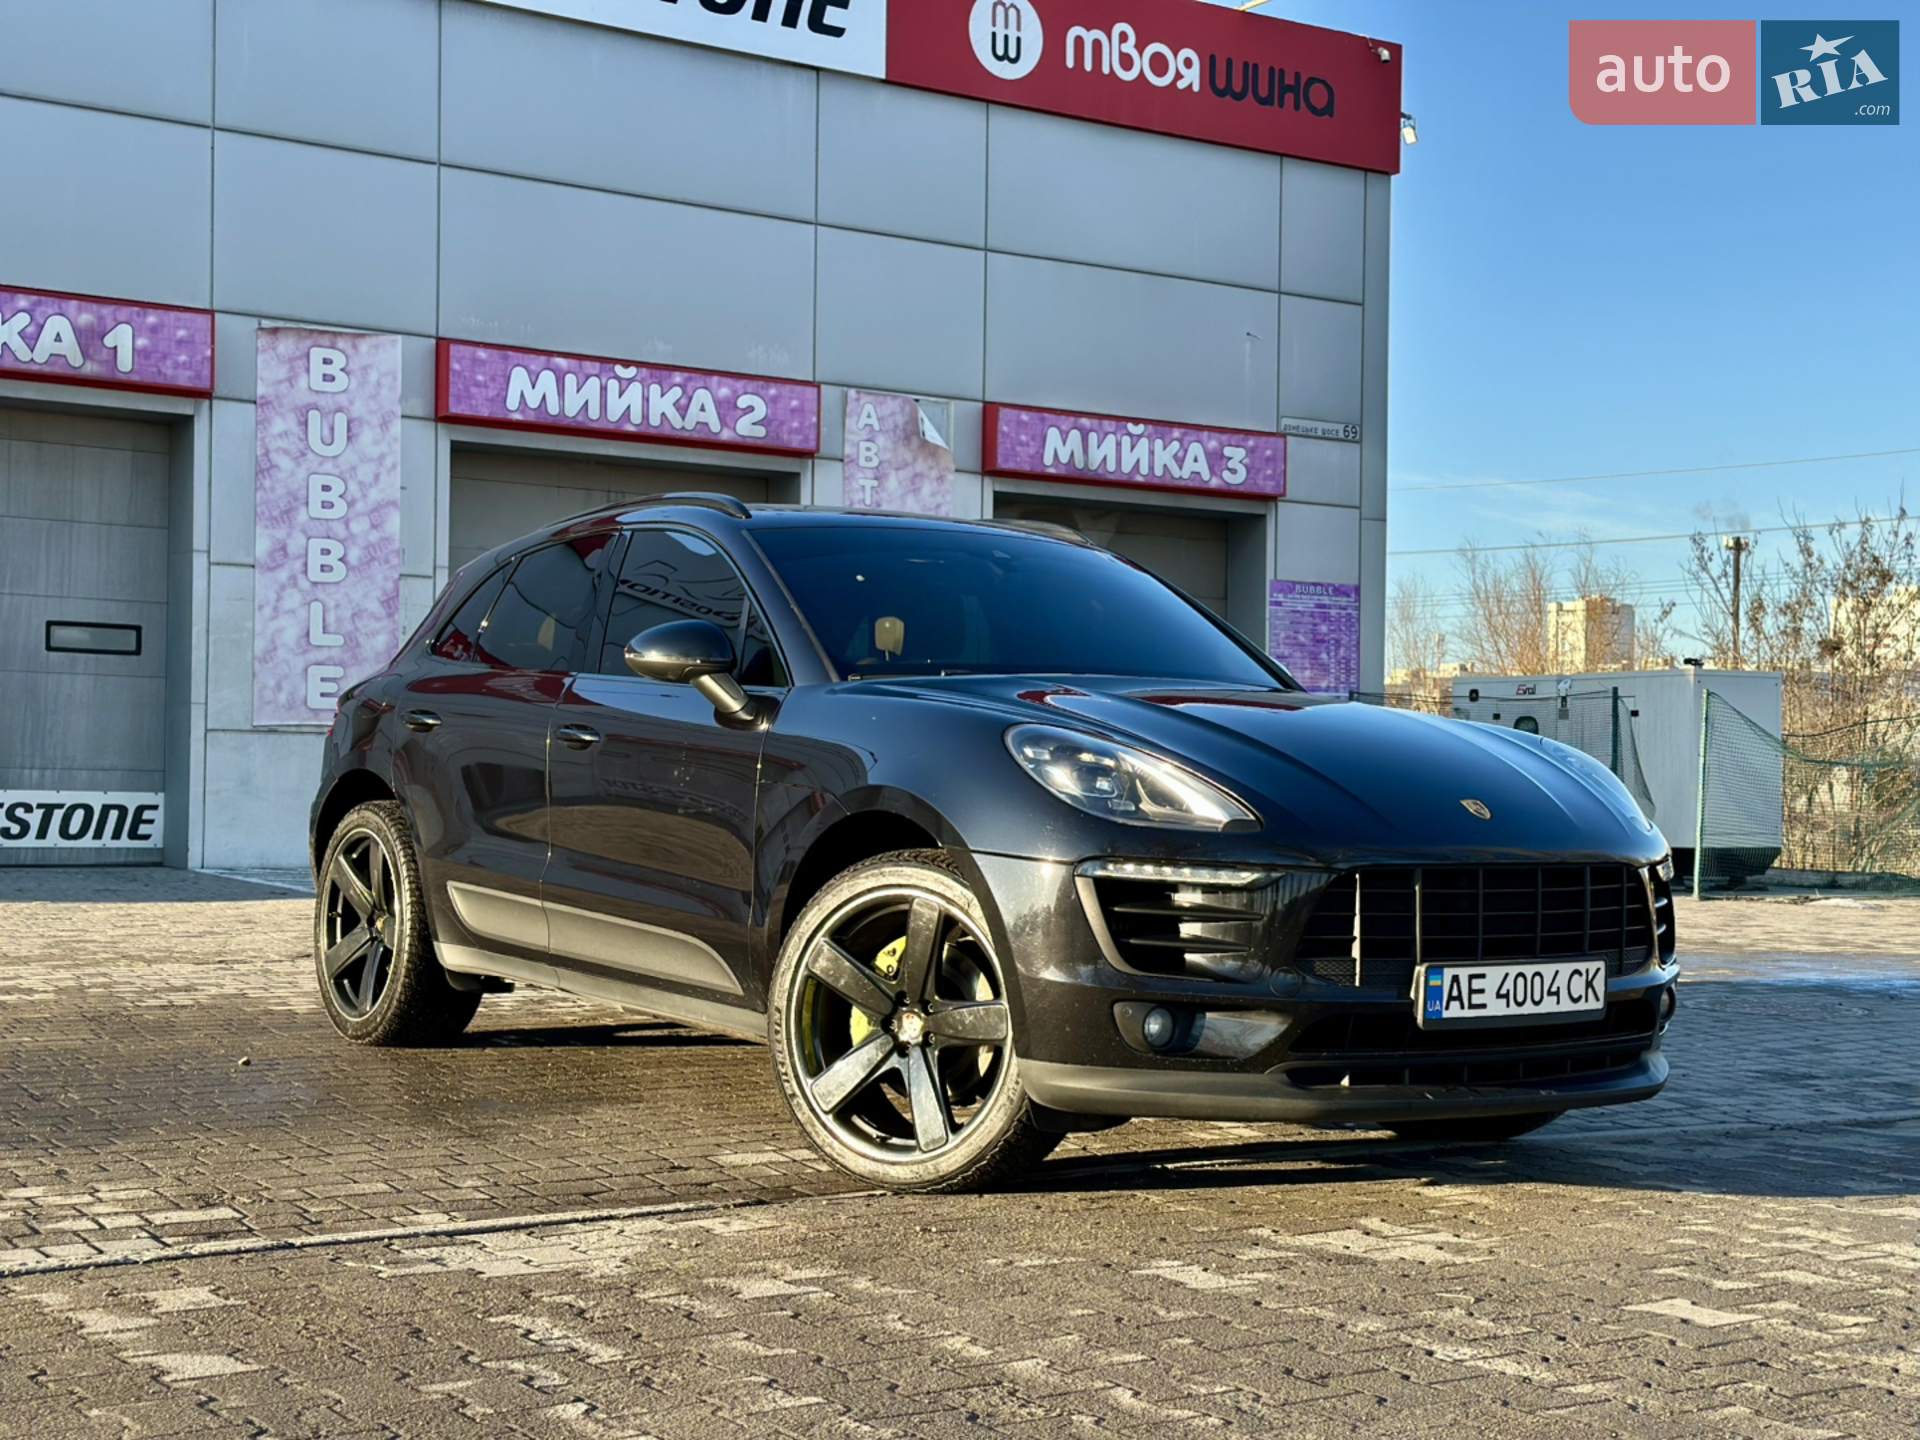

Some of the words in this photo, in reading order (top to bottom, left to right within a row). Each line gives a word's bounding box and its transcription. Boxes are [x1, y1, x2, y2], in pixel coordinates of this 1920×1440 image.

[1209, 54, 1335, 118] шина
[102, 322, 134, 373] 1
[505, 363, 722, 433] МИЙКА
[735, 393, 768, 438] 2
[1042, 422, 1211, 482] МИЙКА
[1221, 446, 1248, 485] 3
[1343, 424, 1358, 439] 69
[1295, 584, 1334, 596] BUBBLE
[0, 801, 159, 841] STONE
[1427, 1000, 1441, 1012] UA
[1444, 973, 1487, 1011] AE
[1495, 969, 1560, 1009] 4004
[1567, 967, 1601, 1005] CK
